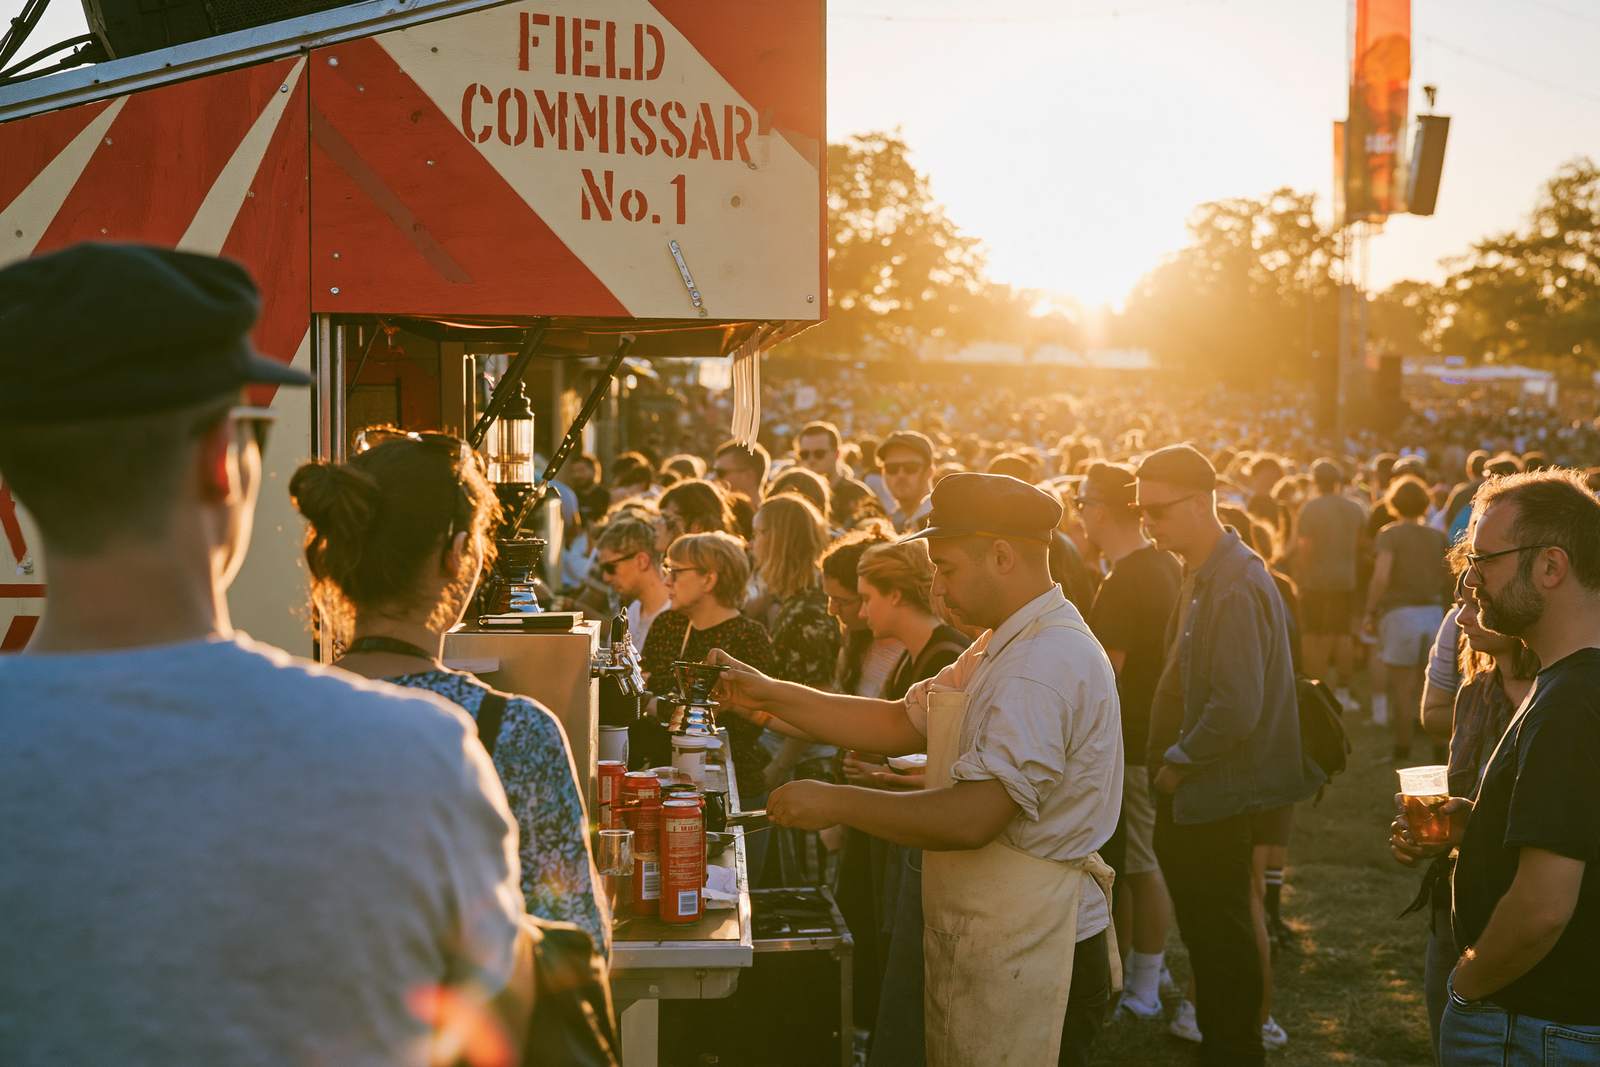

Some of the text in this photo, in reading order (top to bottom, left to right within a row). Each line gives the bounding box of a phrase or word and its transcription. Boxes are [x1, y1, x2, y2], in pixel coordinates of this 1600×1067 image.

[519, 12, 665, 80] FIELD
[461, 83, 770, 161] COMMISSAR
[581, 169, 686, 225] No.1
